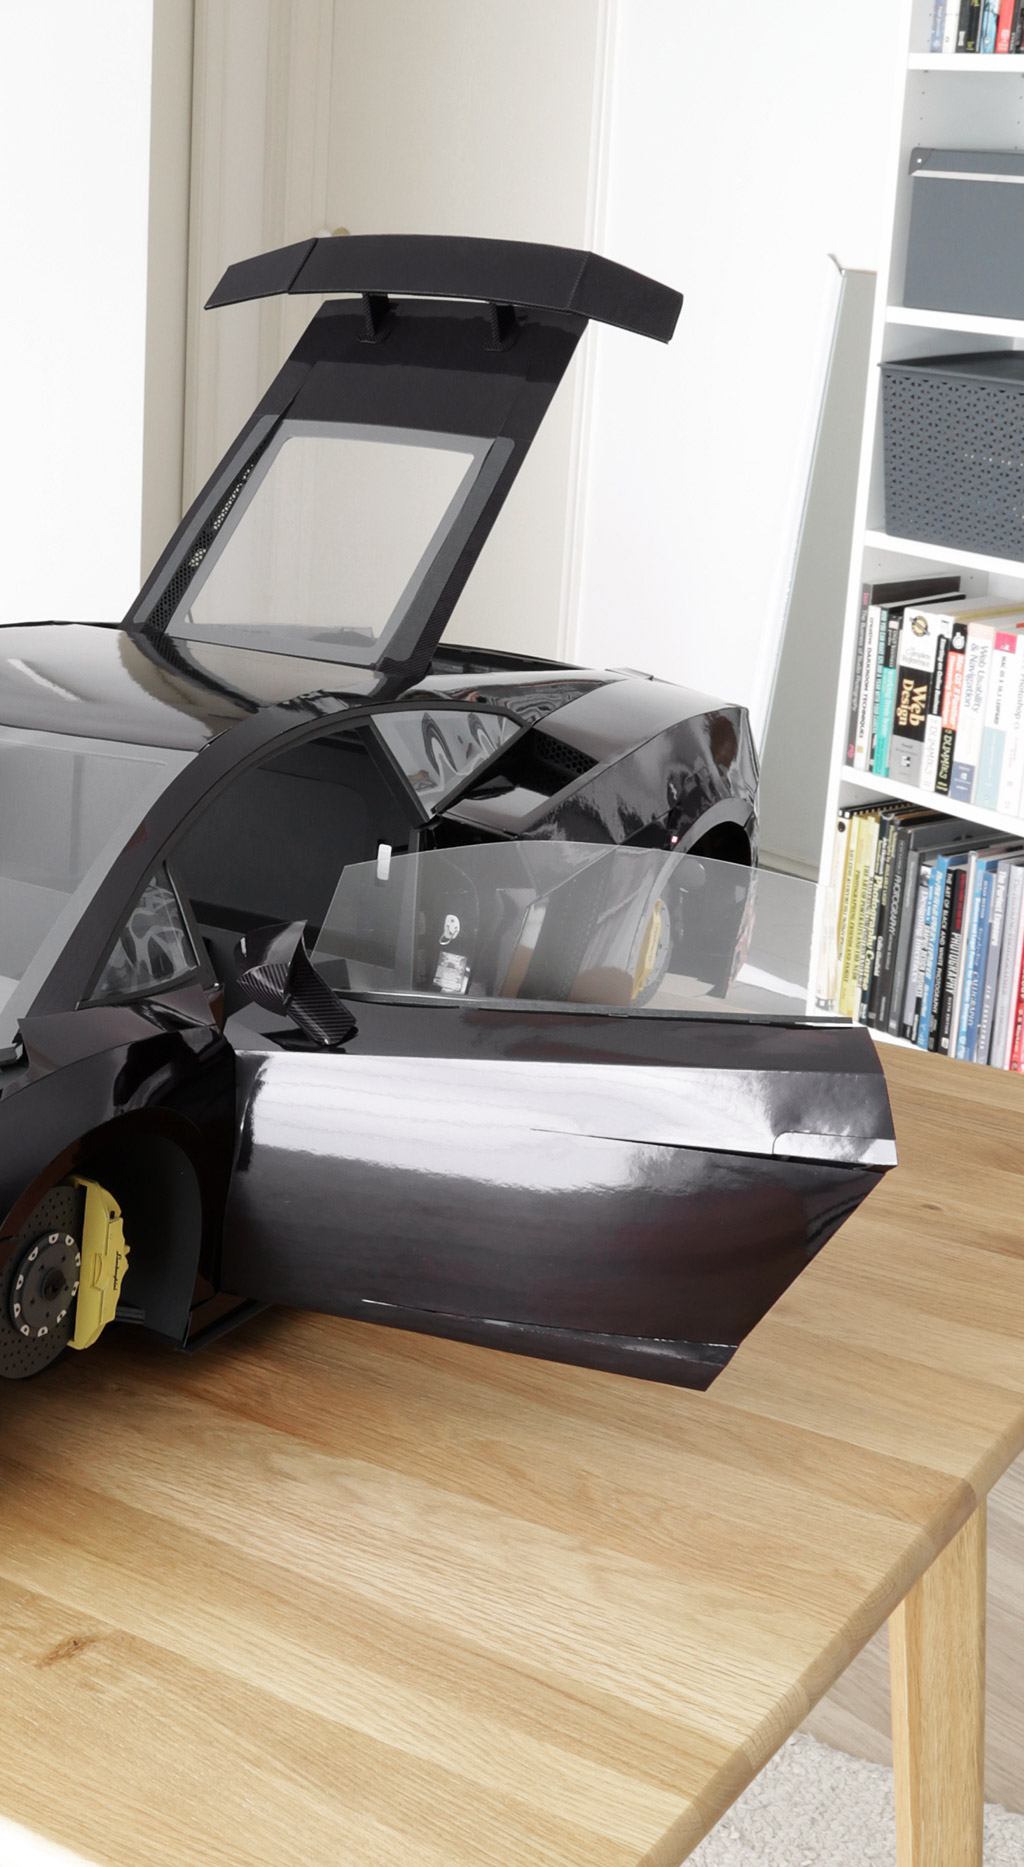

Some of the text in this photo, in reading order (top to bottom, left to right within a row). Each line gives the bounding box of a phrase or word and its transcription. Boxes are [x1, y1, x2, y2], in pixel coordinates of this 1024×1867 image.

[864, 647, 872, 691] DARKROOM
[964, 654, 978, 708] Navigation
[973, 644, 988, 713] Web Usability
[896, 678, 914, 726] Design
[910, 685, 927, 726] Web
[939, 735, 952, 779] DUMMIES
[866, 875, 883, 949] Photography
[888, 874, 902, 935] PHOTOGRAPHY
[991, 871, 1006, 946] The Perfect Exposure
[862, 950, 875, 991] Course
[933, 967, 942, 1014] PHOTOGRAPHY
[945, 932, 962, 995] PHOTOGRAPHY
[968, 971, 979, 1026] CALLIGRAPHY
